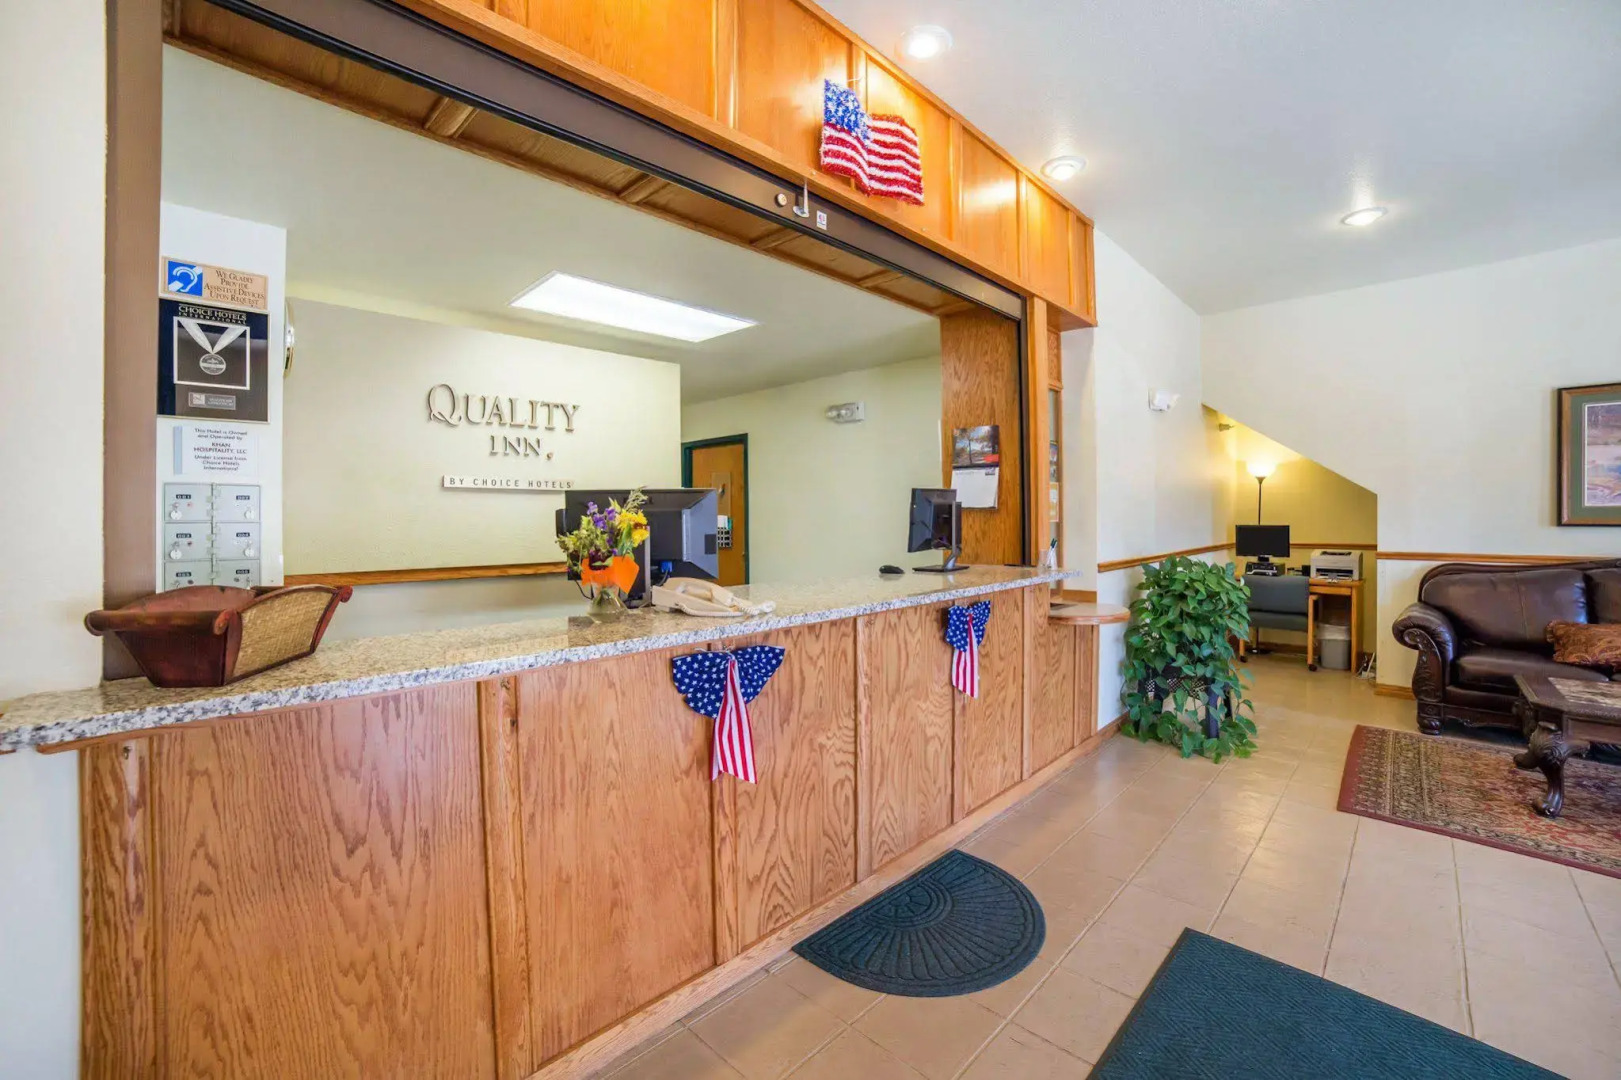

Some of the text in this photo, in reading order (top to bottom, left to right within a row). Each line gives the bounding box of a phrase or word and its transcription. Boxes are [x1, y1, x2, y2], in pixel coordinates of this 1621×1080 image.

[178, 311, 246, 325] INTERNATIONAL
[179, 305, 247, 321] CHOICE HOTELS
[427, 383, 580, 432] QUALITY
[449, 476, 572, 489] BY CHOICE HOTELS
